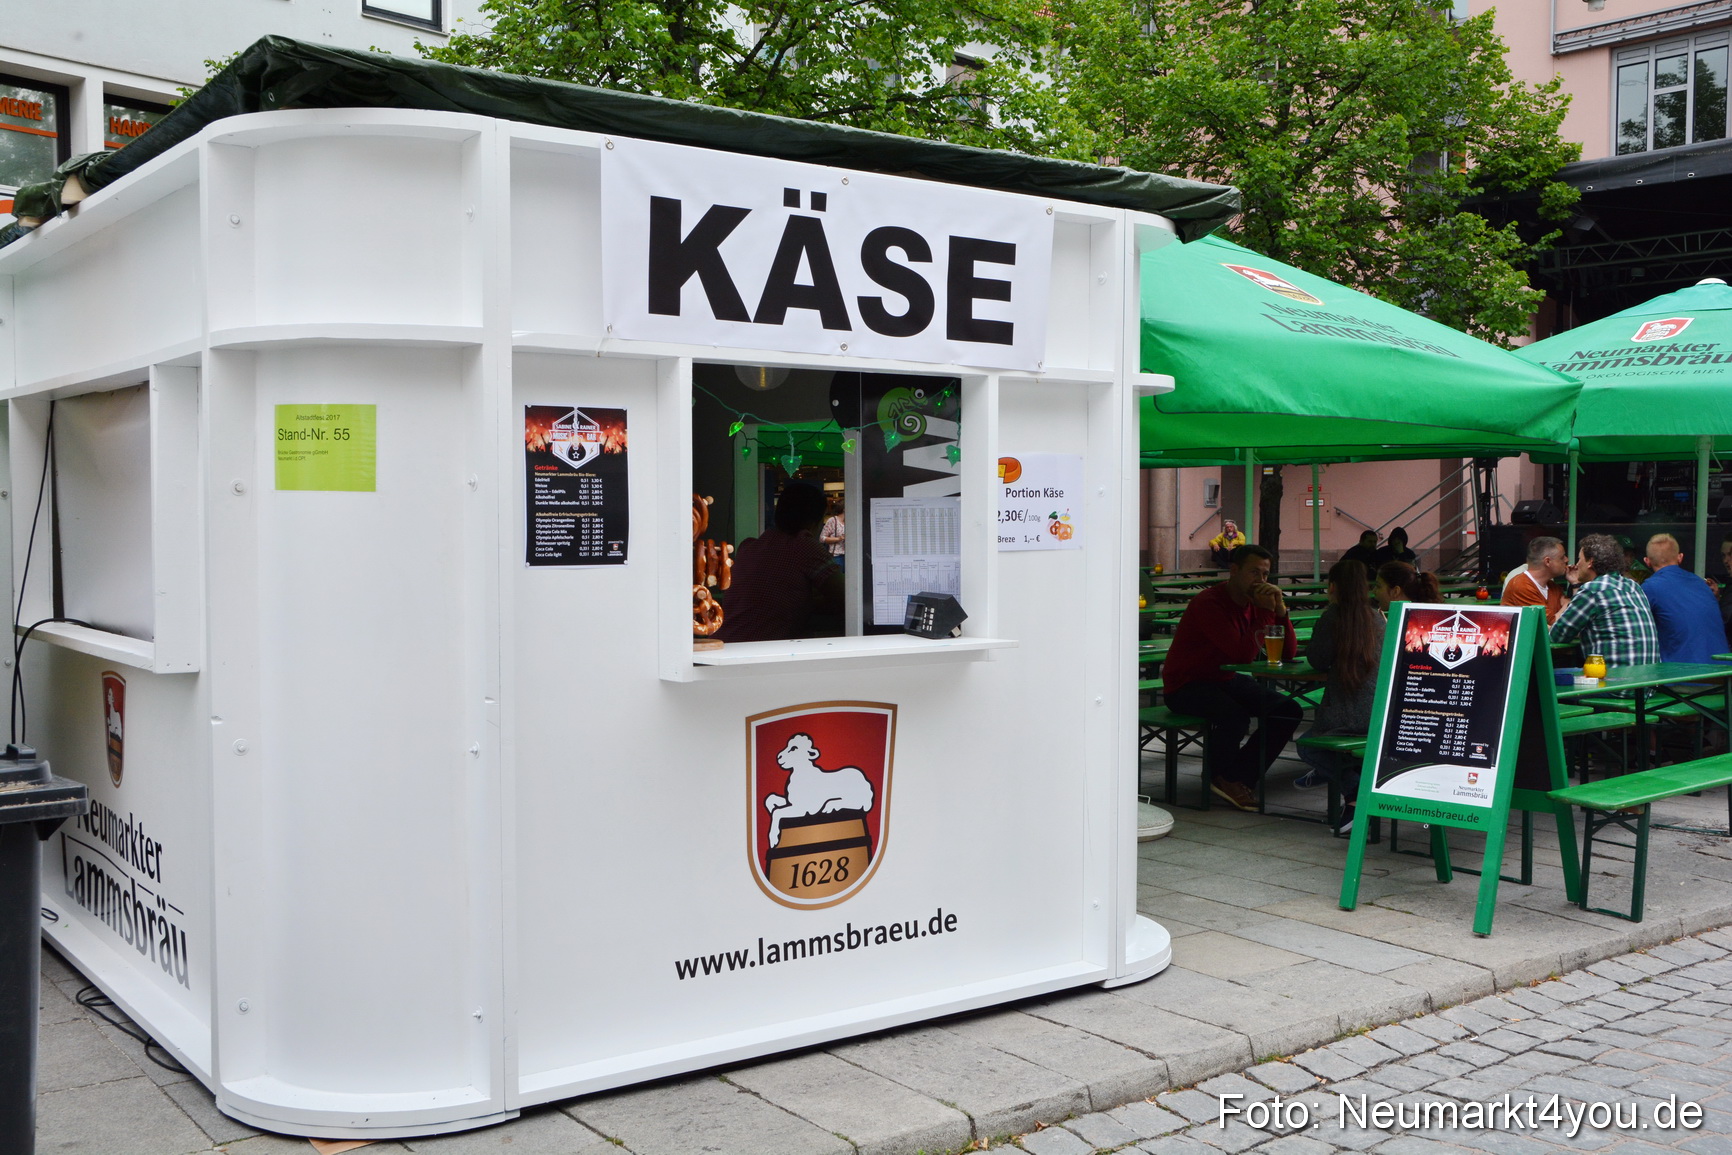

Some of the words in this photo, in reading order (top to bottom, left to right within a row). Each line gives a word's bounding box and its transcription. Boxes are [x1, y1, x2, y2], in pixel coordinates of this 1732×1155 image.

[648, 187, 1016, 346] KÄSE
[1569, 342, 1720, 360] Neumarkter
[1539, 350, 1732, 372] ammsbräu
[1586, 370, 1687, 380] ÖKOLOGISCHE
[278, 428, 329, 441] Stand-Nr.
[333, 428, 350, 441] 55
[1006, 487, 1040, 498] Portion
[1044, 487, 1064, 498] Käse
[998, 535, 1016, 543] Breze
[1453, 790, 1488, 800] Lammsbräu
[1378, 802, 1480, 823] www.lammsbraeu.de
[788, 856, 850, 890] 1628
[60, 831, 190, 991] Lammsbräu
[675, 908, 958, 980] www.lammsbraeu.de
